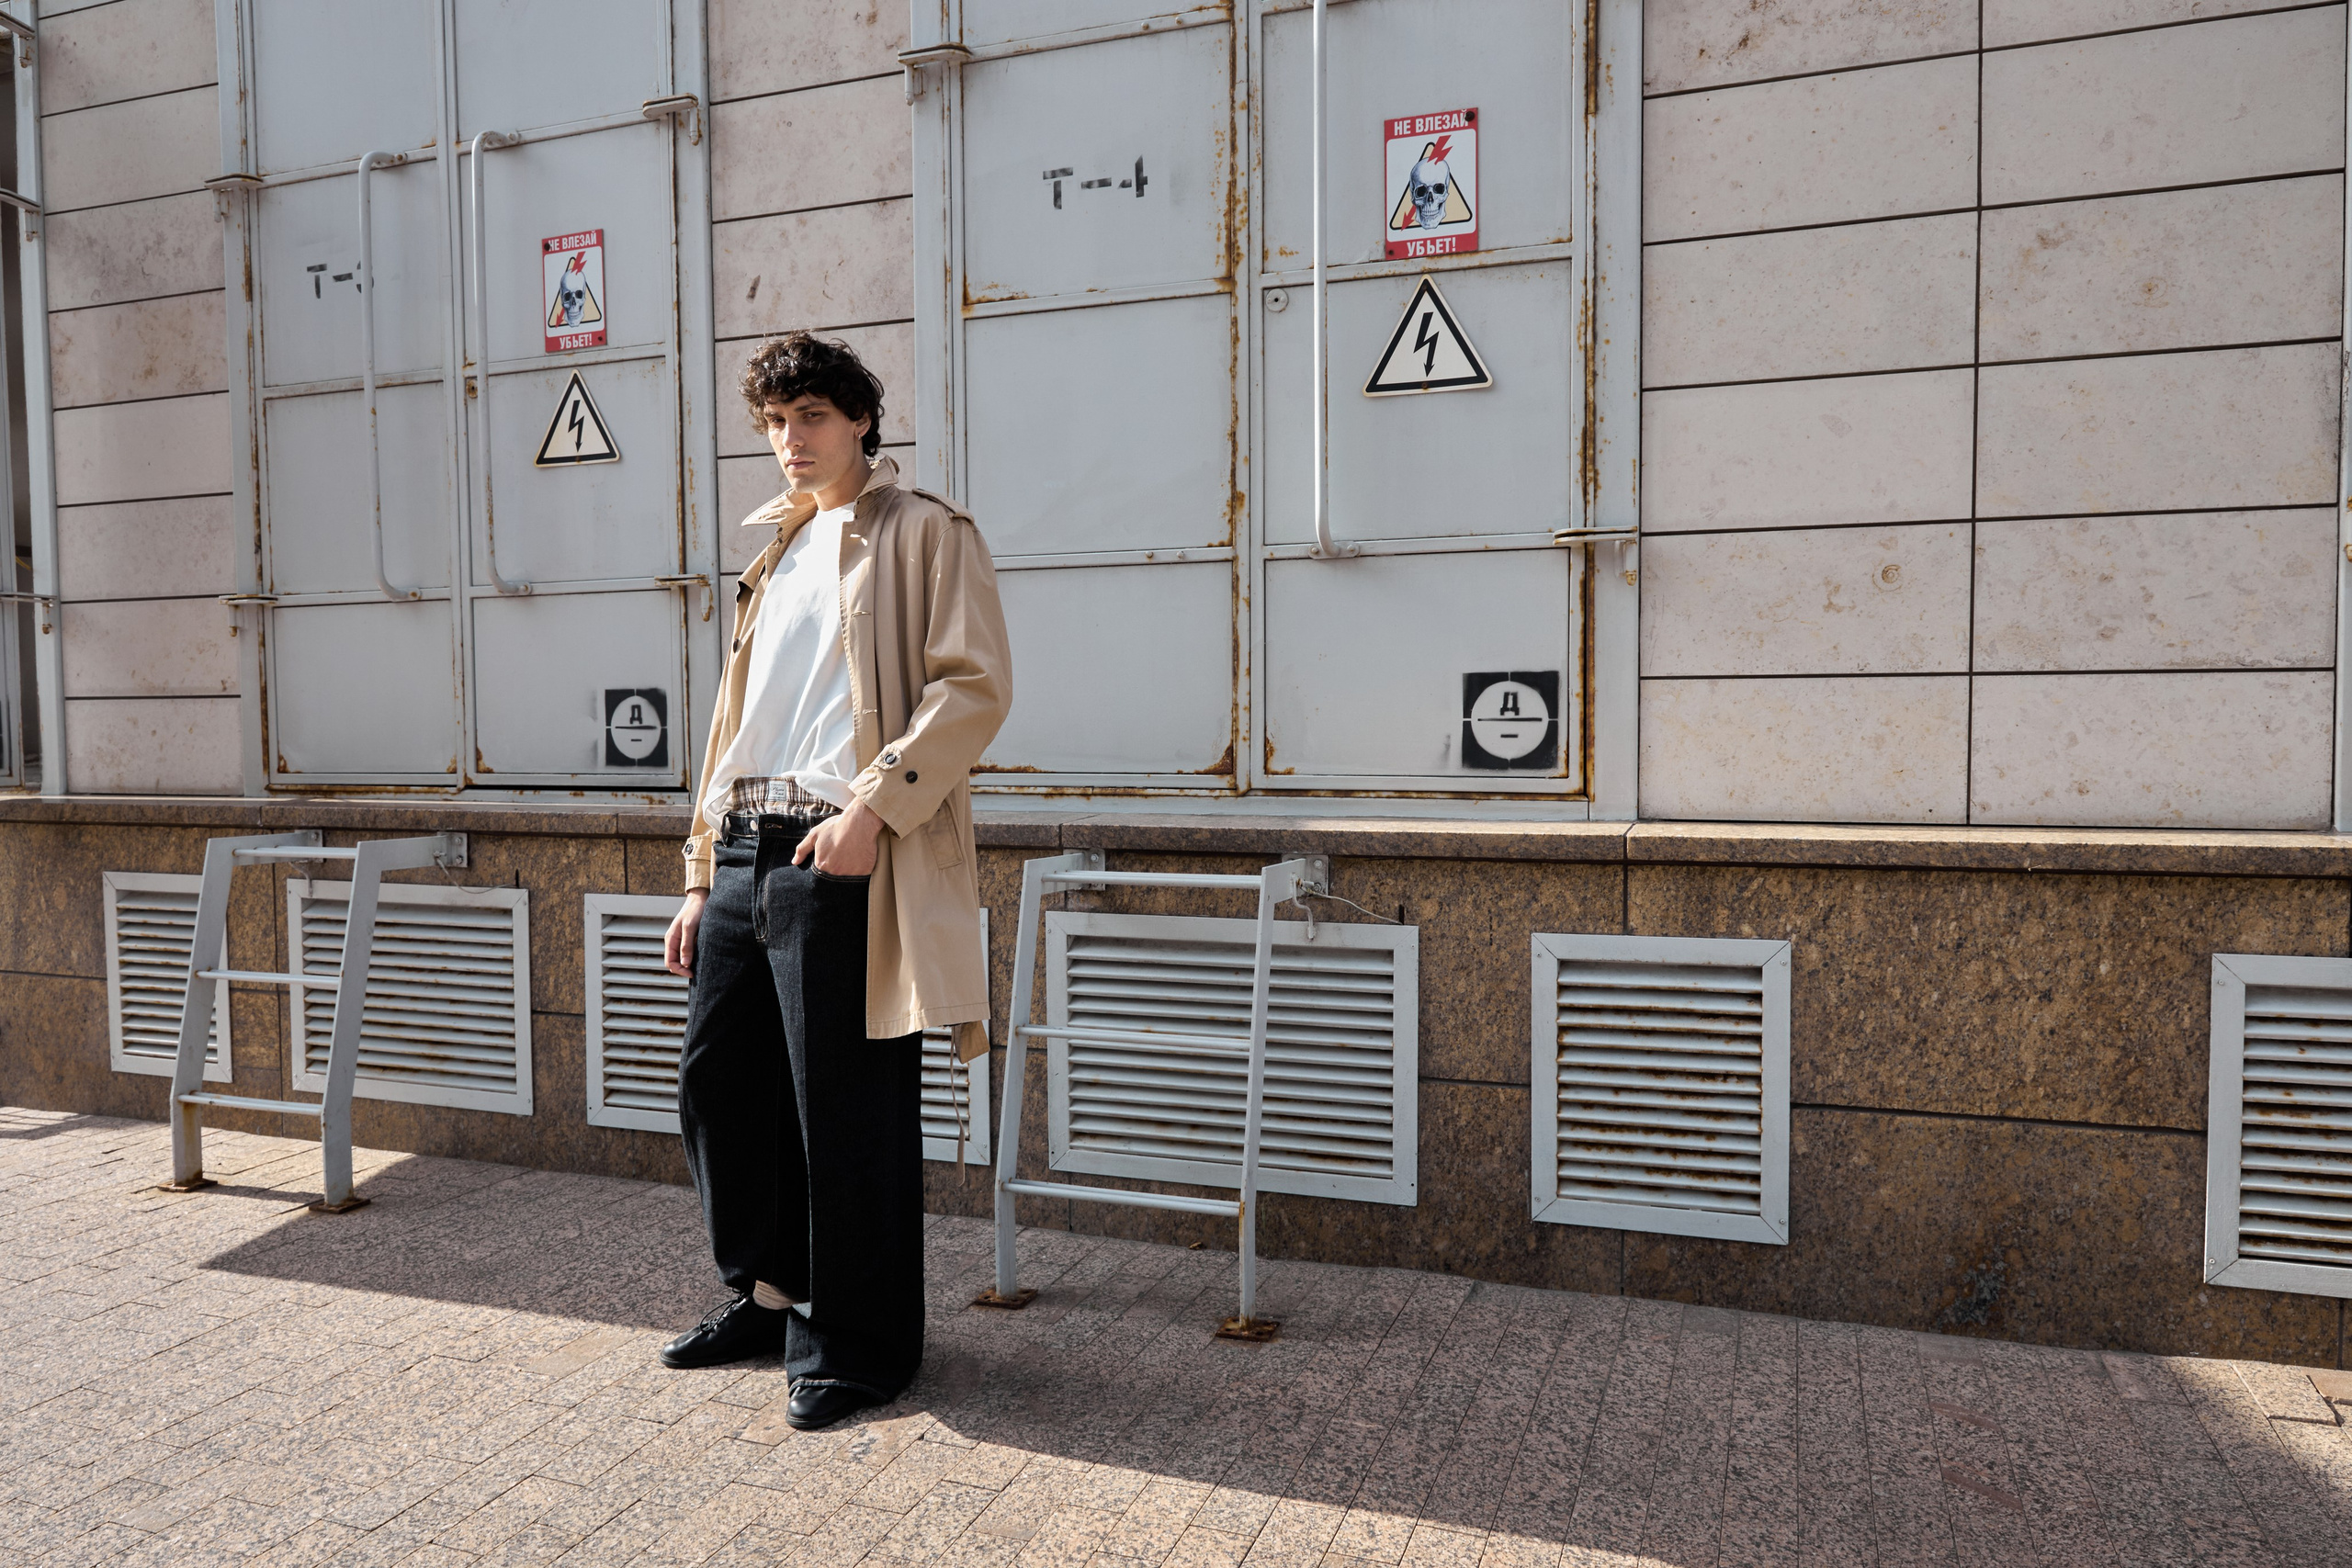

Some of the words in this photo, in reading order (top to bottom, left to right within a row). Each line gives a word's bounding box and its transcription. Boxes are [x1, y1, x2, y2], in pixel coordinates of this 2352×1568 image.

[1394, 120, 1411, 136] НЕ
[1416, 108, 1469, 133] ВЛЕЗАЙ
[548, 238, 560, 253] НЕ
[561, 230, 597, 252] ВЛЕЗАЙ
[1407, 237, 1456, 257] УБЬЕТ!
[559, 333, 593, 350] УБЬЕТ!
[629, 704, 643, 725] Д
[1499, 691, 1520, 716] Д
